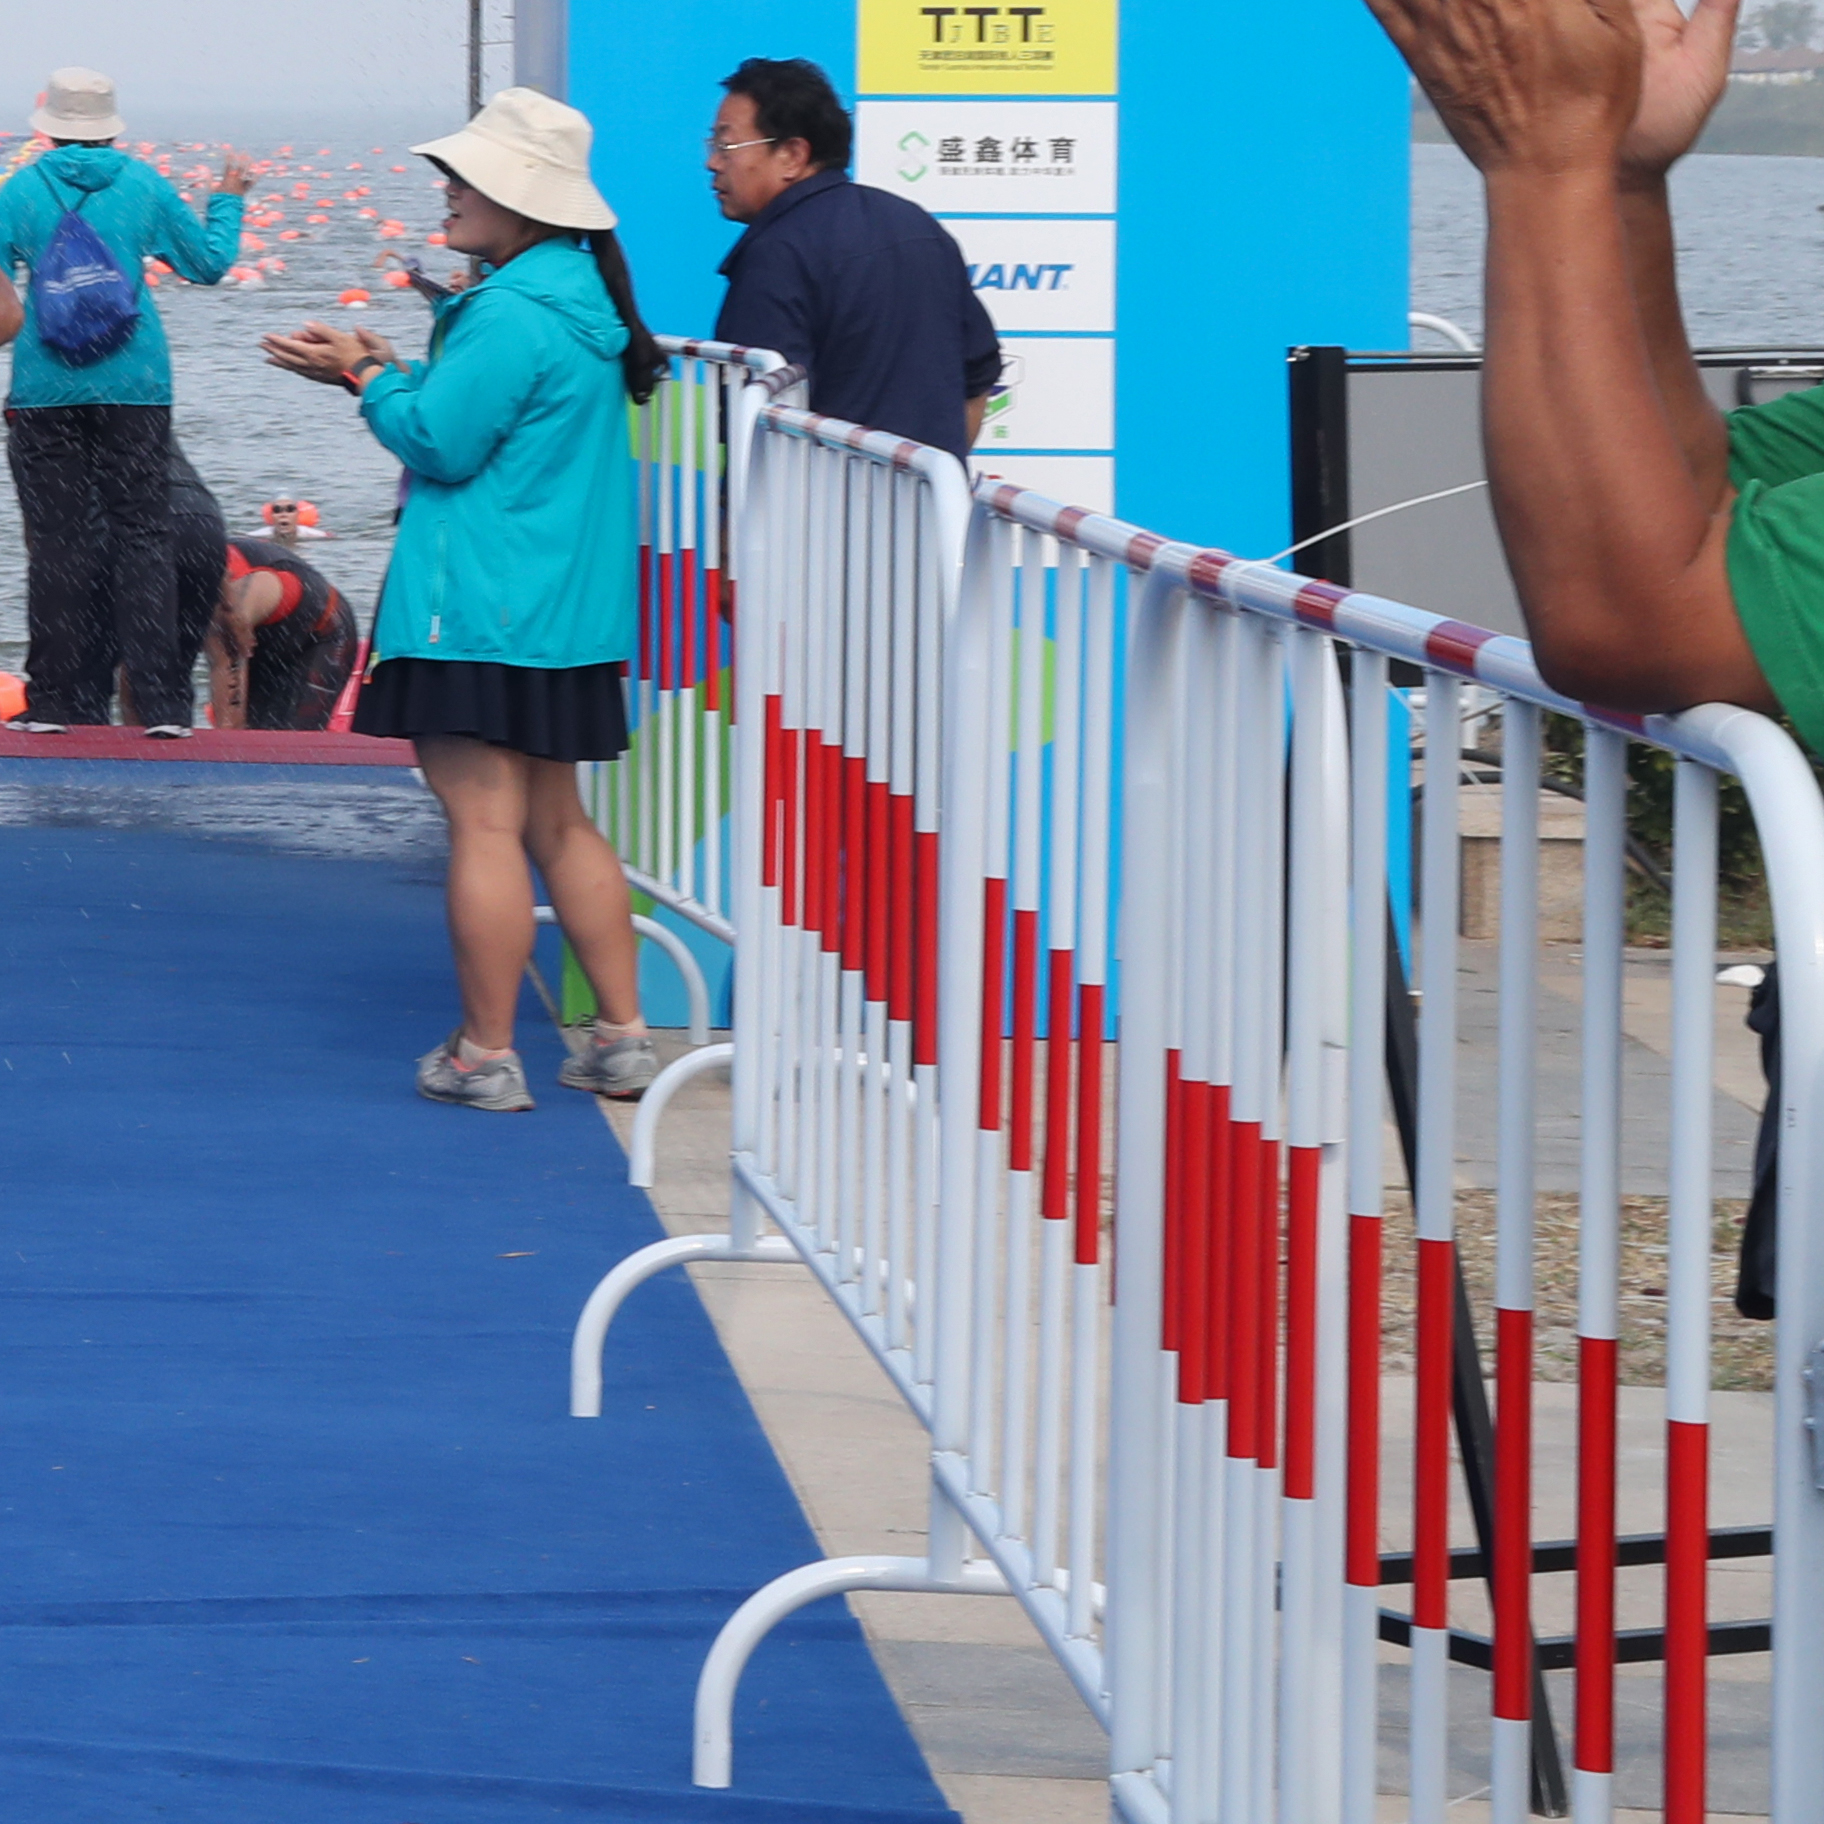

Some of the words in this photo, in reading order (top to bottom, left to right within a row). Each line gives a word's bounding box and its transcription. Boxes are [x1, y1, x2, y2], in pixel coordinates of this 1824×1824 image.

[936, 135, 1077, 164] 盛鑫体育
[965, 262, 1076, 291] IANT
